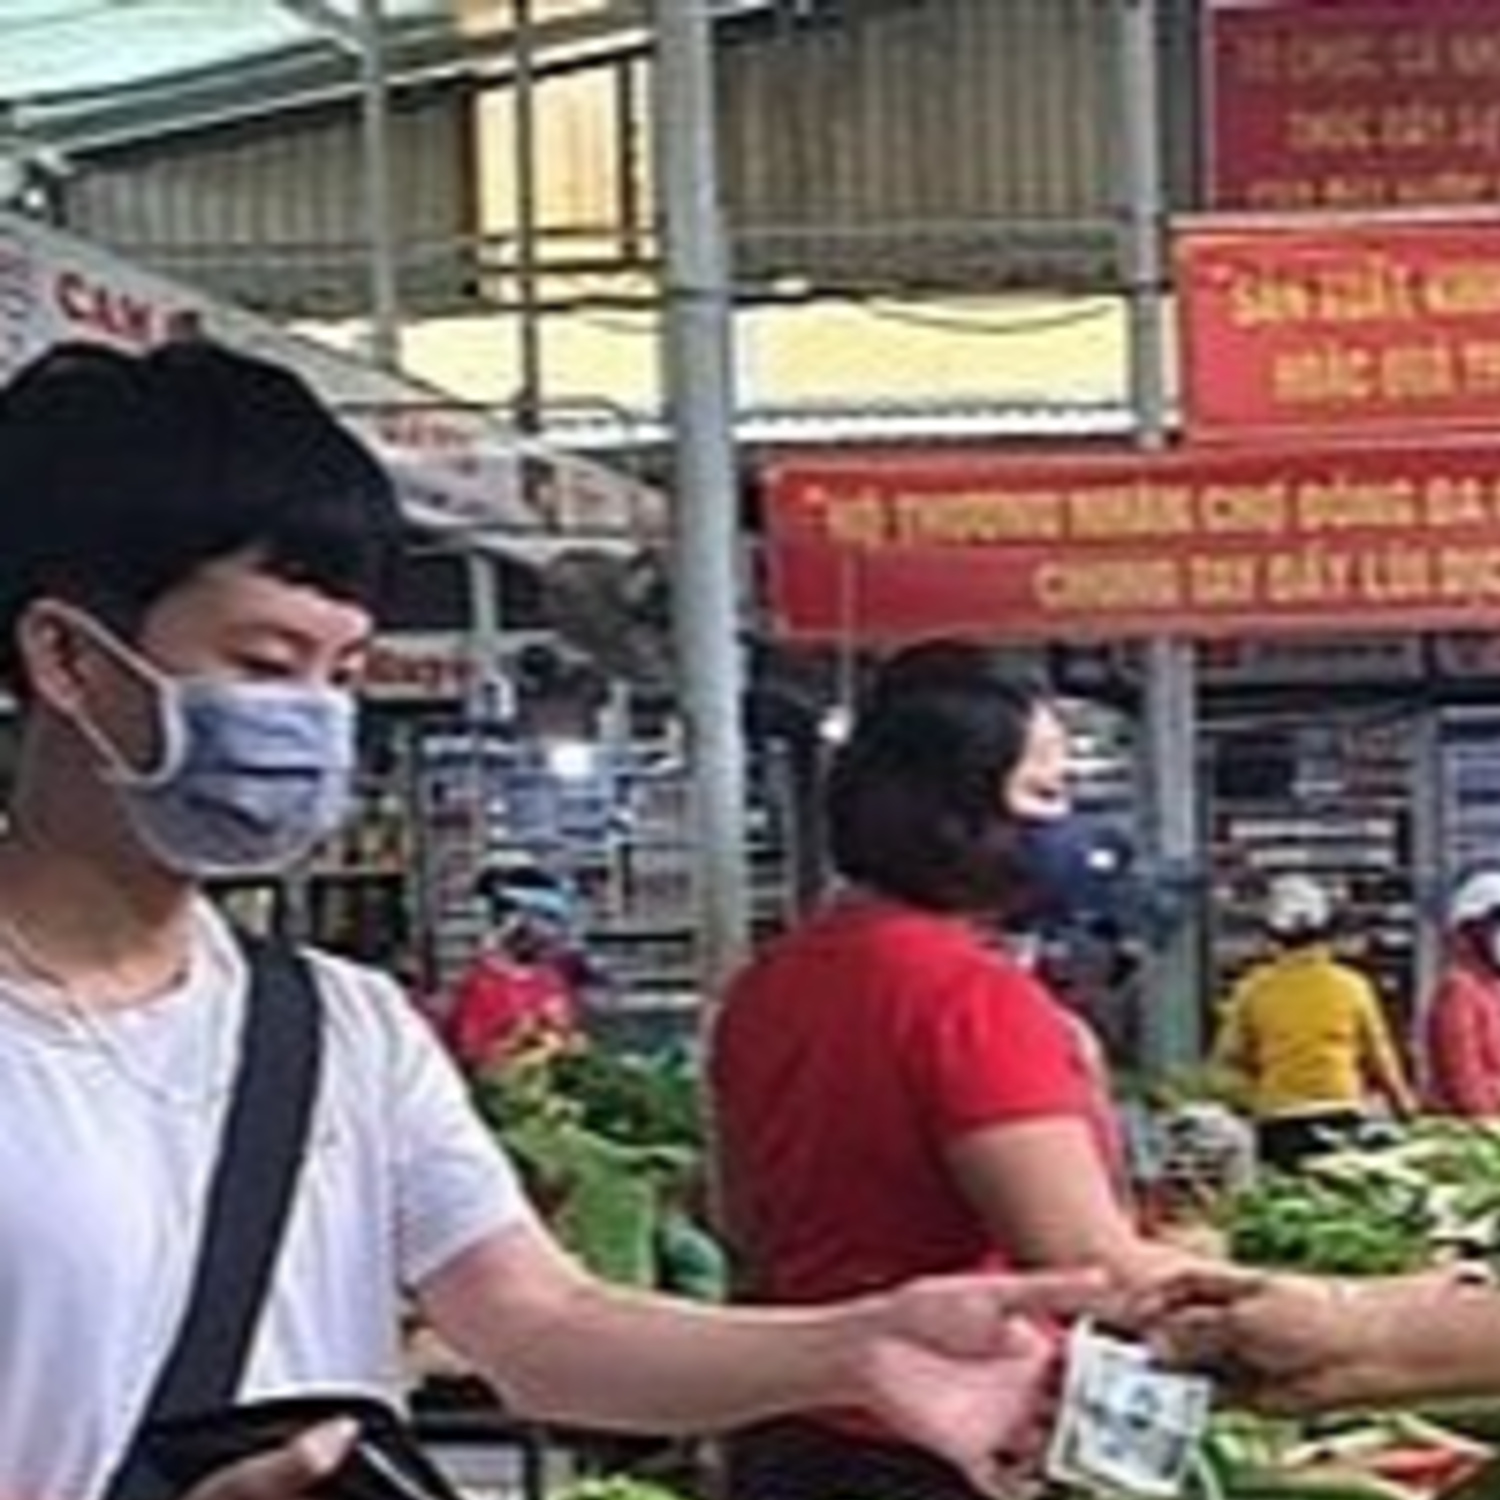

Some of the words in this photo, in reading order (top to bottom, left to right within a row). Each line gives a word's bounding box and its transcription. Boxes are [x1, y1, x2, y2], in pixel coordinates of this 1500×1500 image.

[1069, 476, 1193, 536] NHÂN
[1034, 556, 1181, 608] CHUNG
[1191, 552, 1258, 602] TAY
